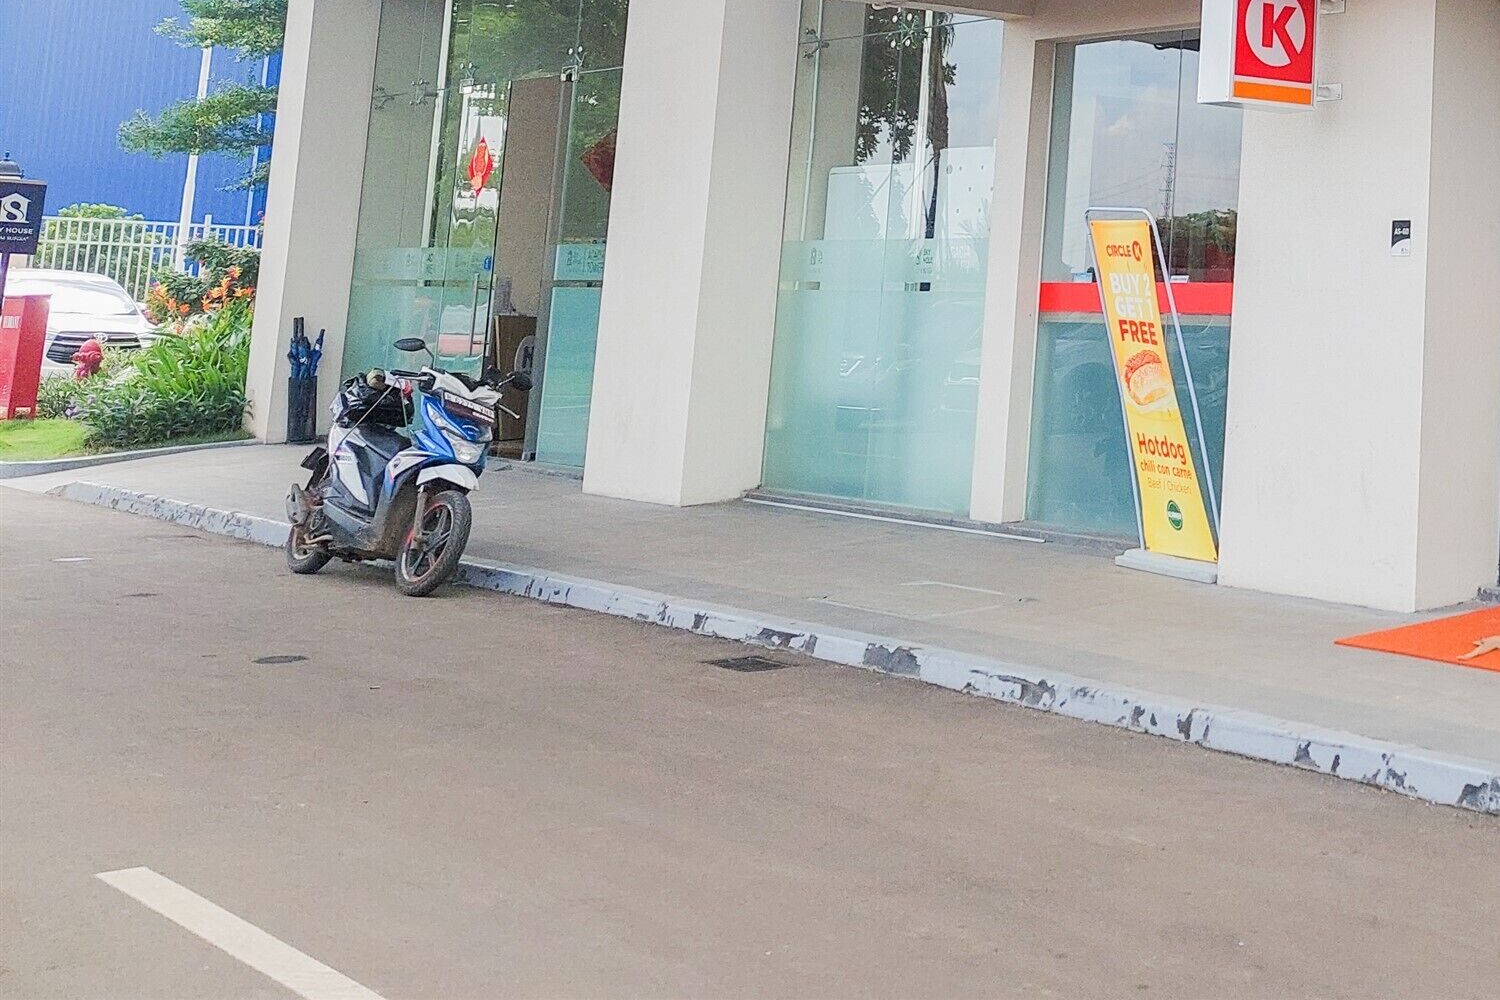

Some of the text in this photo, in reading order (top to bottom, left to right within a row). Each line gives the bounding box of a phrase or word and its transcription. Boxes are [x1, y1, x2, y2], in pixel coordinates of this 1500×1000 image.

[5, 227, 34, 235] HOUSE
[1106, 244, 1132, 257] CIRCLE
[1109, 272, 1152, 297] BUY 2
[1114, 296, 1154, 321] GET 1
[1118, 319, 1158, 346] FREE
[1137, 432, 1187, 466] Hotdog
[1140, 459, 1192, 480] chili con carne
